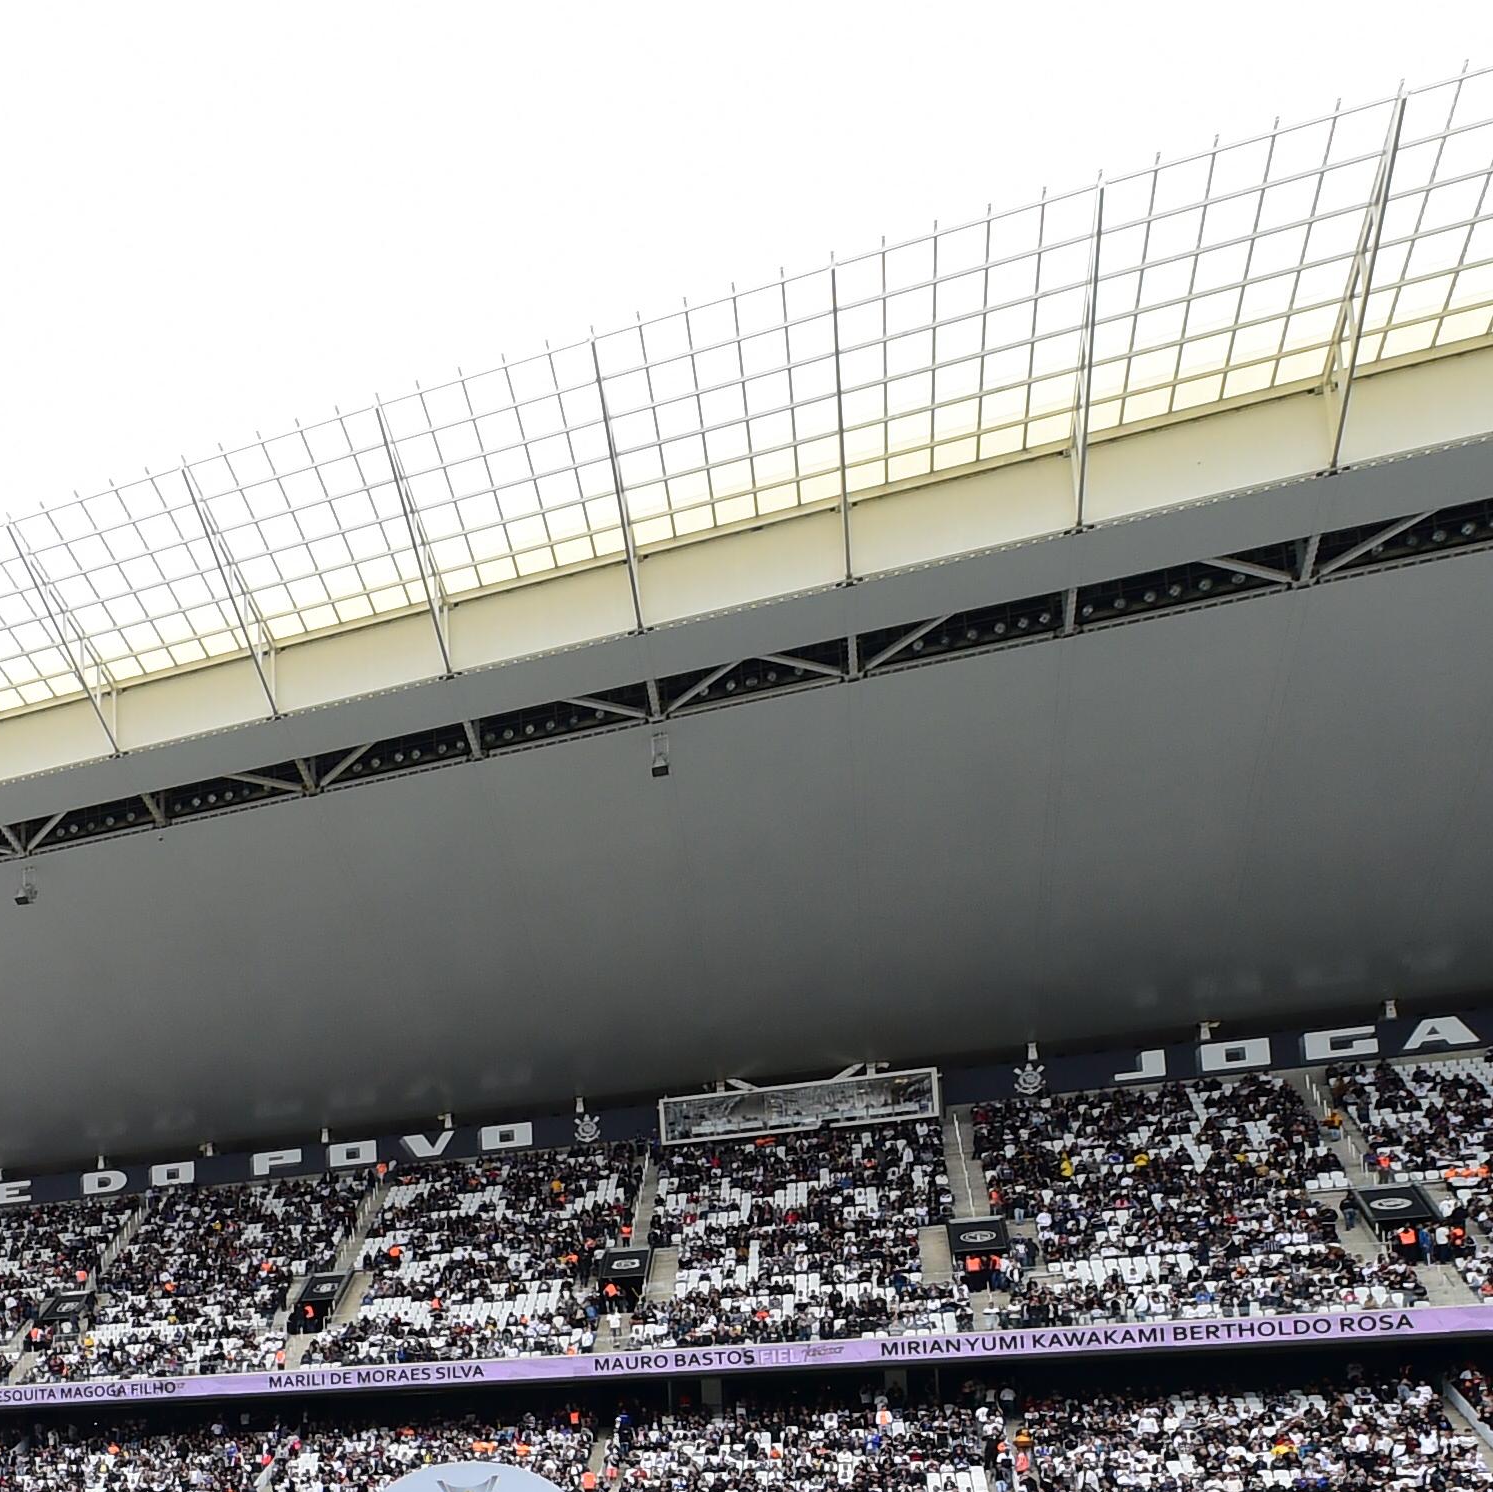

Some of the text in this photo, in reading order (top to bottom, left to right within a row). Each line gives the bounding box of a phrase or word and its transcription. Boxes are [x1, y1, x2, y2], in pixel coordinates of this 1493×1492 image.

[1114, 1015, 1481, 1082] JOGA
[81, 1160, 195, 1196] DO
[251, 1121, 532, 1176] POVO
[881, 1312, 1414, 1357] MIRIAN YUMI KAWAKAMI BERTHOLDO ROSA
[268, 1363, 485, 1390] MARILI DE MORAES SILVA
[594, 1354, 669, 1372] MAURO
[674, 1349, 754, 1368] BASTOS
[60, 1384, 126, 1399] MAGOGA
[130, 1381, 177, 1396] FILHO
